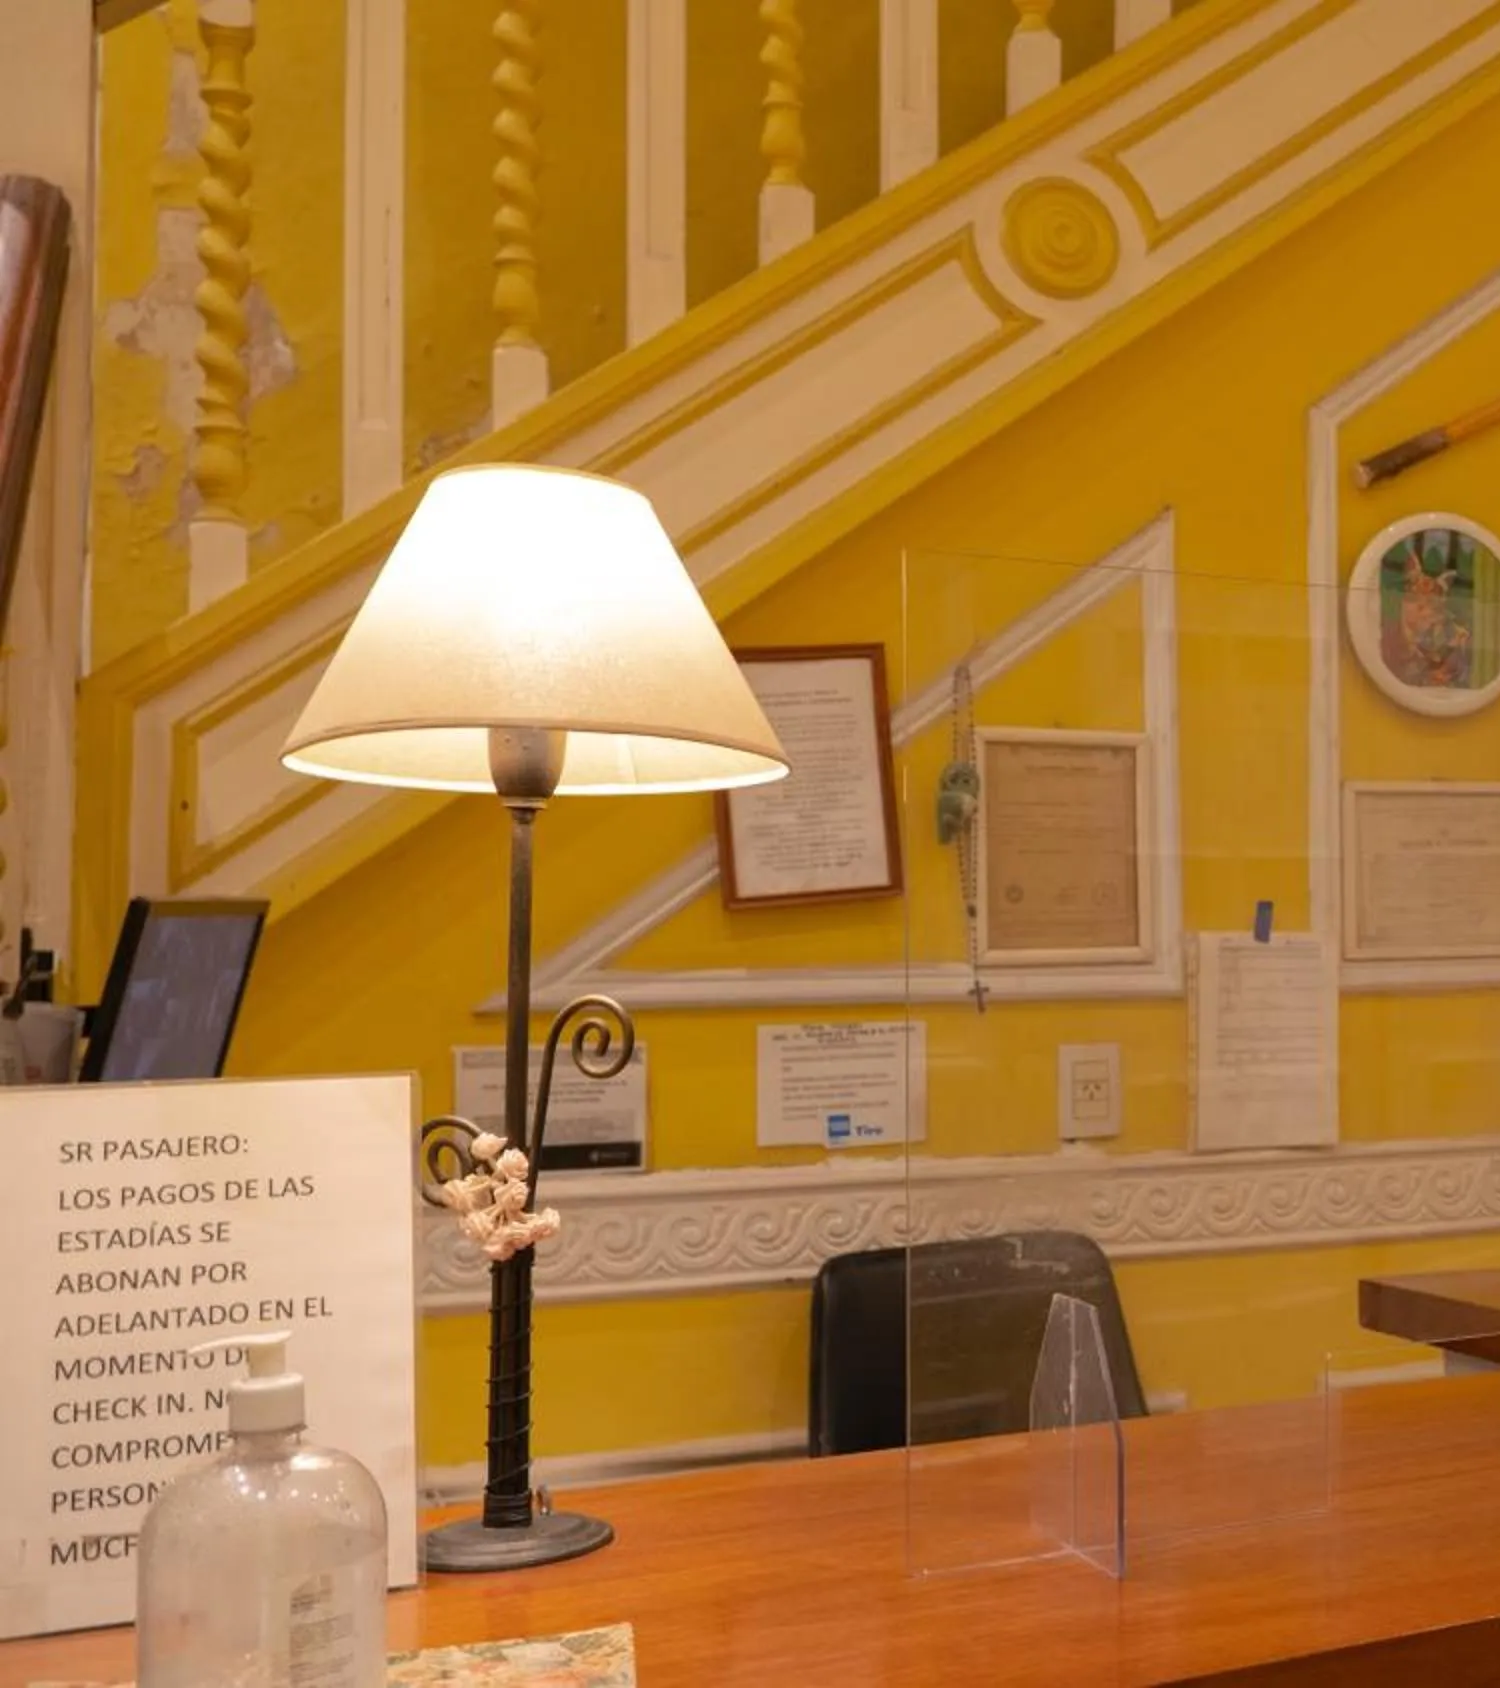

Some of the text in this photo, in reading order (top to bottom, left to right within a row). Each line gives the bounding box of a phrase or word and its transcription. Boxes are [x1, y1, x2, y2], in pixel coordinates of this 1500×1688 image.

[59, 1134, 249, 1164] SR PASAJERO:
[58, 1175, 315, 1212] LOS PAGOS DE LAS
[57, 1221, 232, 1254] ESTADÍAS SE
[55, 1260, 248, 1295] ABONAN POR
[55, 1296, 333, 1339] ADELANTADO EN EL
[54, 1349, 215, 1381] MOMENTO
[52, 1387, 230, 1426] CHECK IN. N
